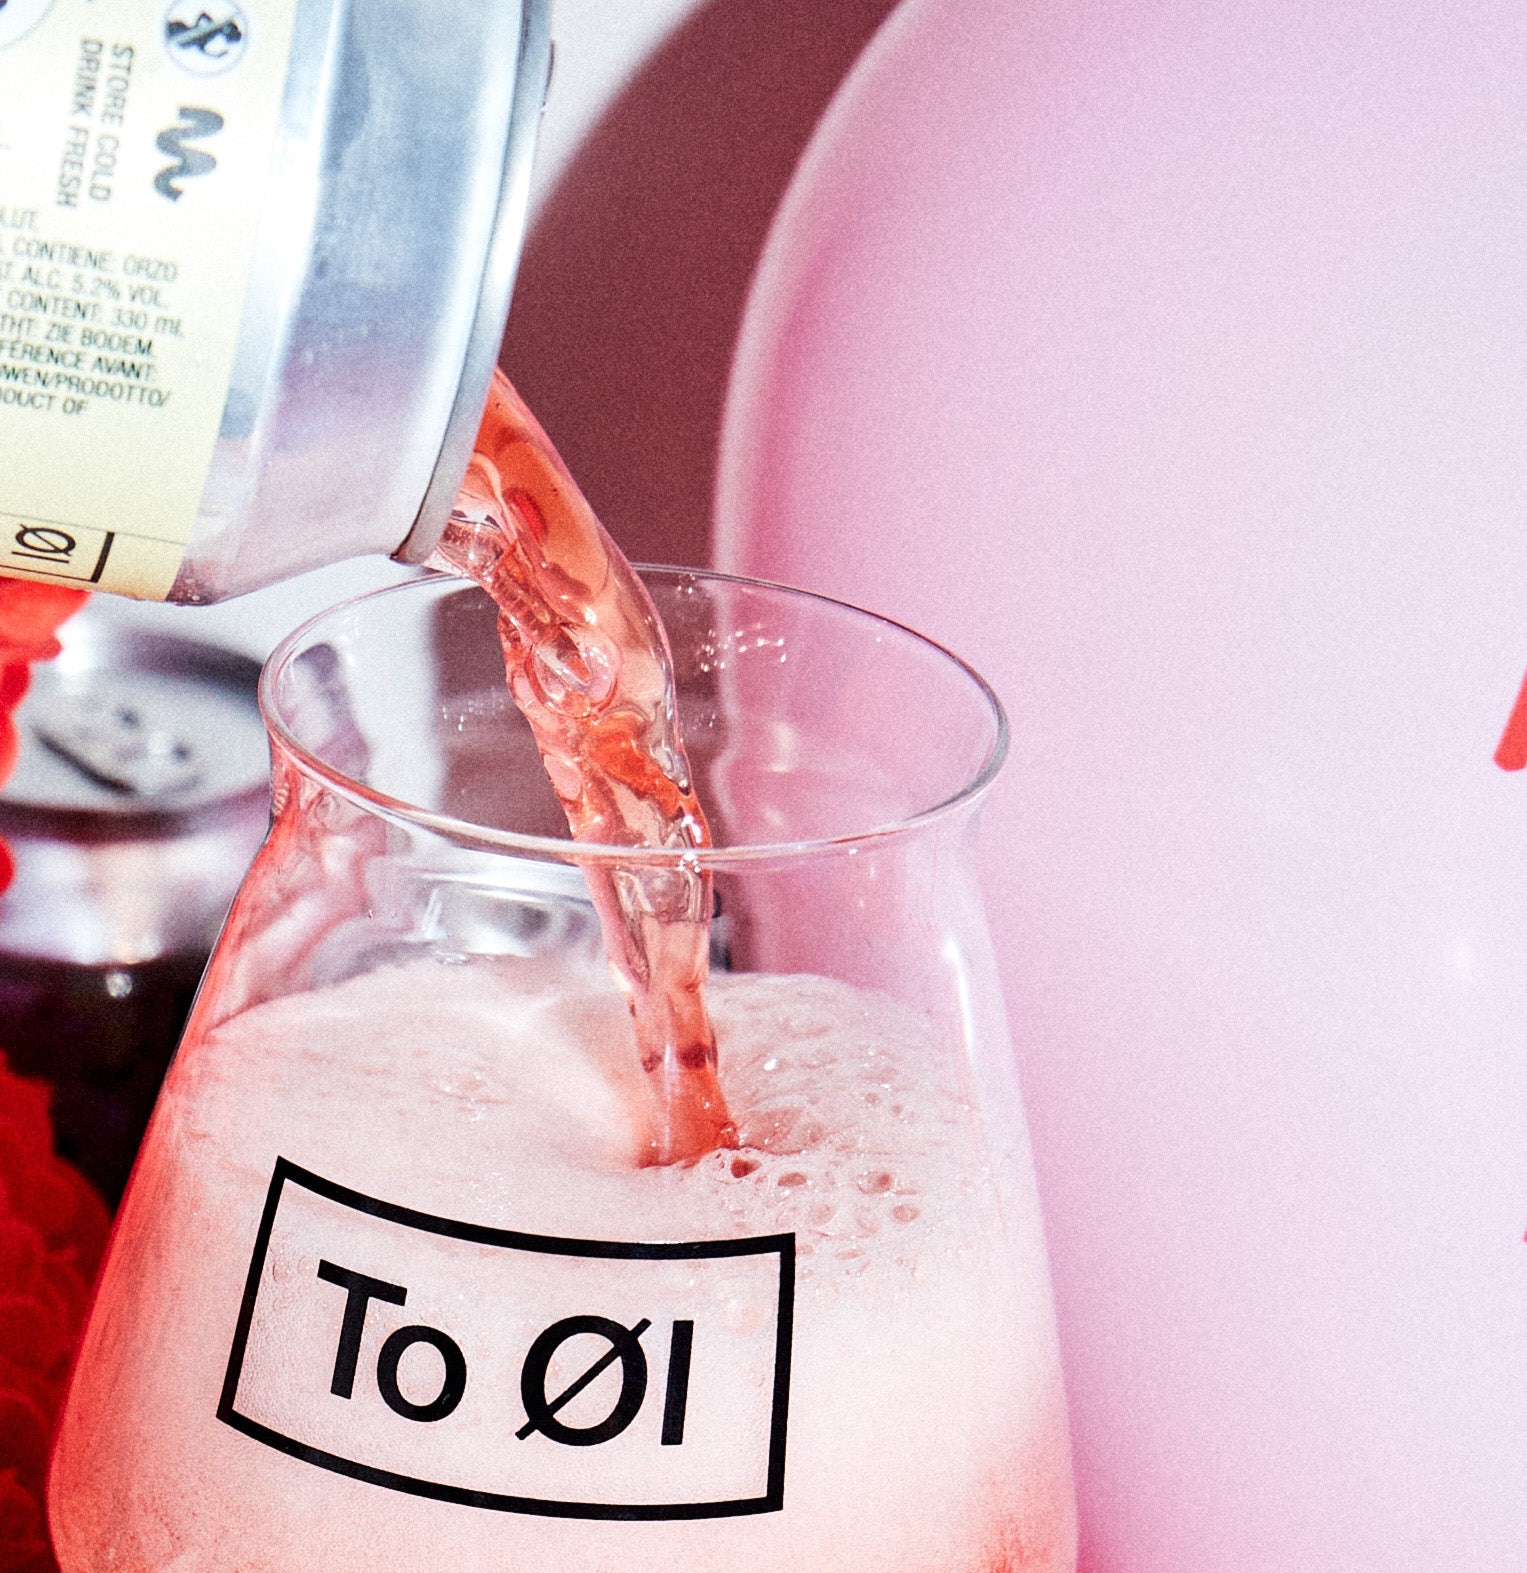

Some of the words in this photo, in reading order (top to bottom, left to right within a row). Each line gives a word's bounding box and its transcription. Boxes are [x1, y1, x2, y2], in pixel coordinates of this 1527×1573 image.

[72, 38, 104, 116] DRINK
[101, 43, 134, 126] STORE
[56, 126, 89, 208] FRESH
[88, 134, 120, 202] COLD
[123, 257, 175, 282] ORZO
[47, 322, 73, 342] ZIE
[112, 308, 148, 329] 330
[63, 398, 87, 416] OF
[317, 1259, 468, 1422] To
[515, 1315, 695, 1446] Øl
